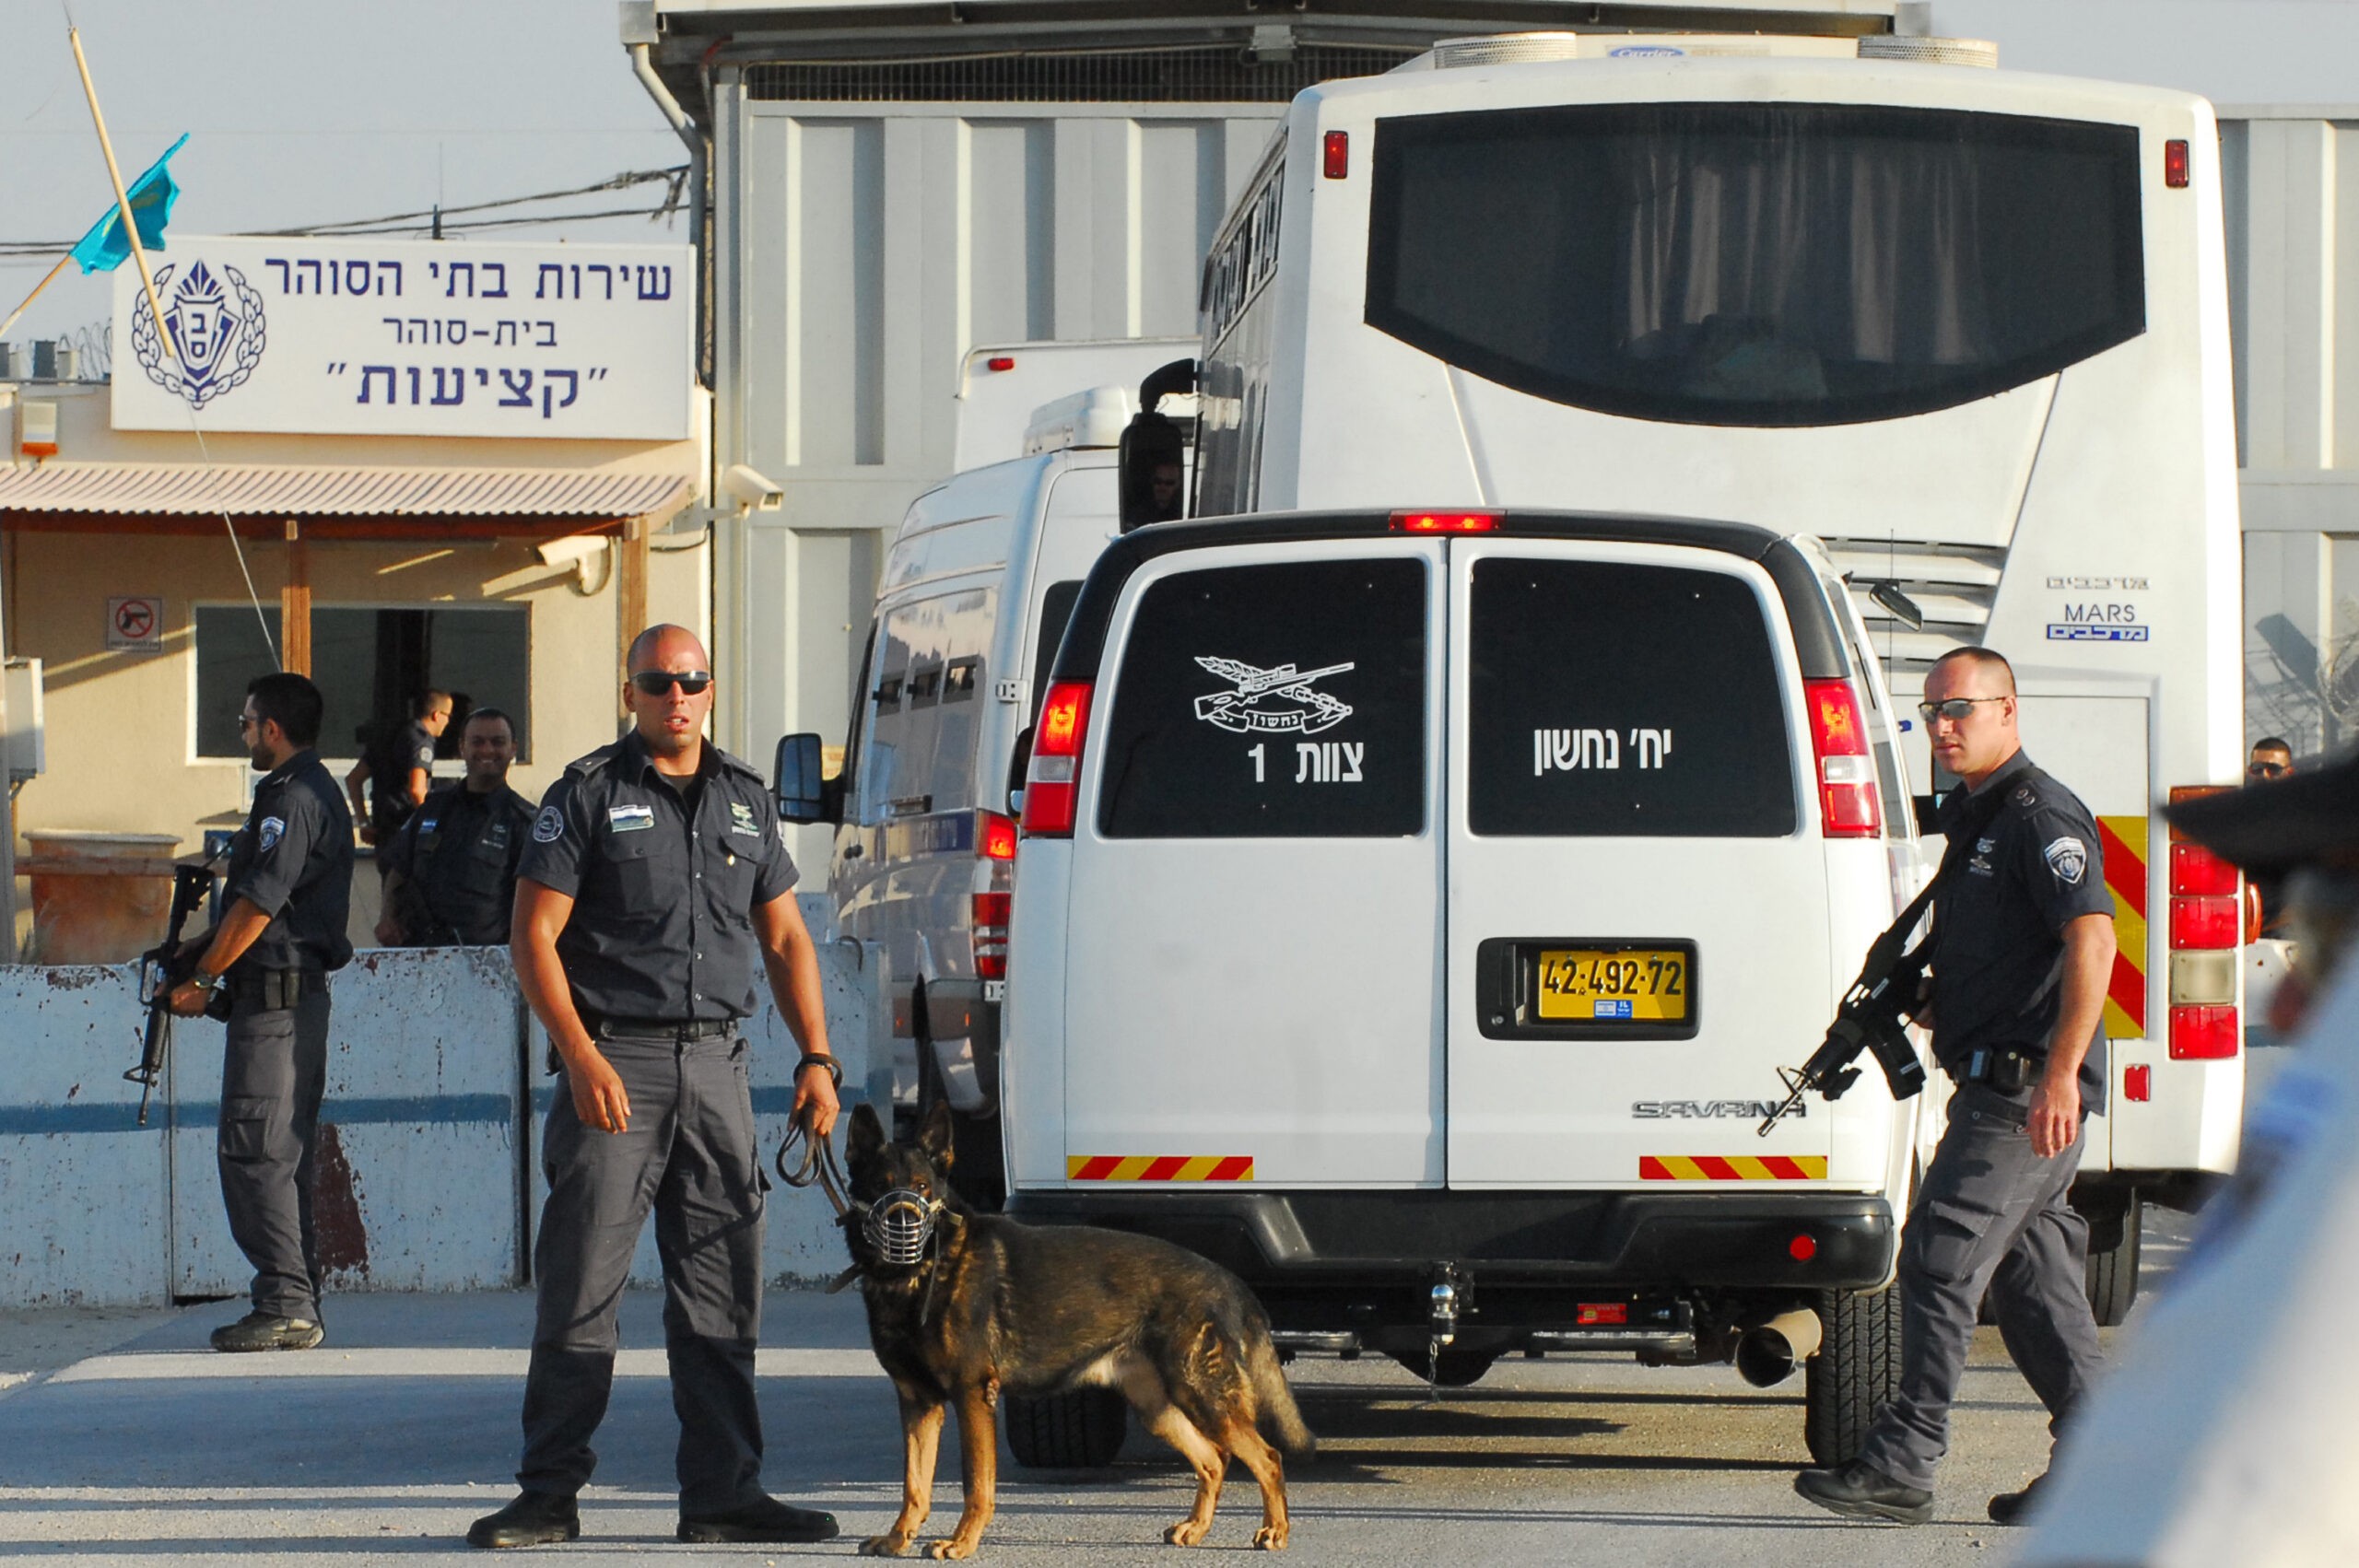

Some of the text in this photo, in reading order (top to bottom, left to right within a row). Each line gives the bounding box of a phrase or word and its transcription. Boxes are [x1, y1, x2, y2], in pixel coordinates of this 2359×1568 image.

[265, 259, 672, 300] שירות בתי הסוהר
[383, 318, 557, 347] בית-סוהר
[2065, 603, 2136, 623] MARS
[1252, 713, 1299, 729] נחשון
[1248, 742, 1364, 784] צוות 1
[1534, 729, 1620, 777] נחשון
[1632, 1101, 1806, 1118] SAVANA
